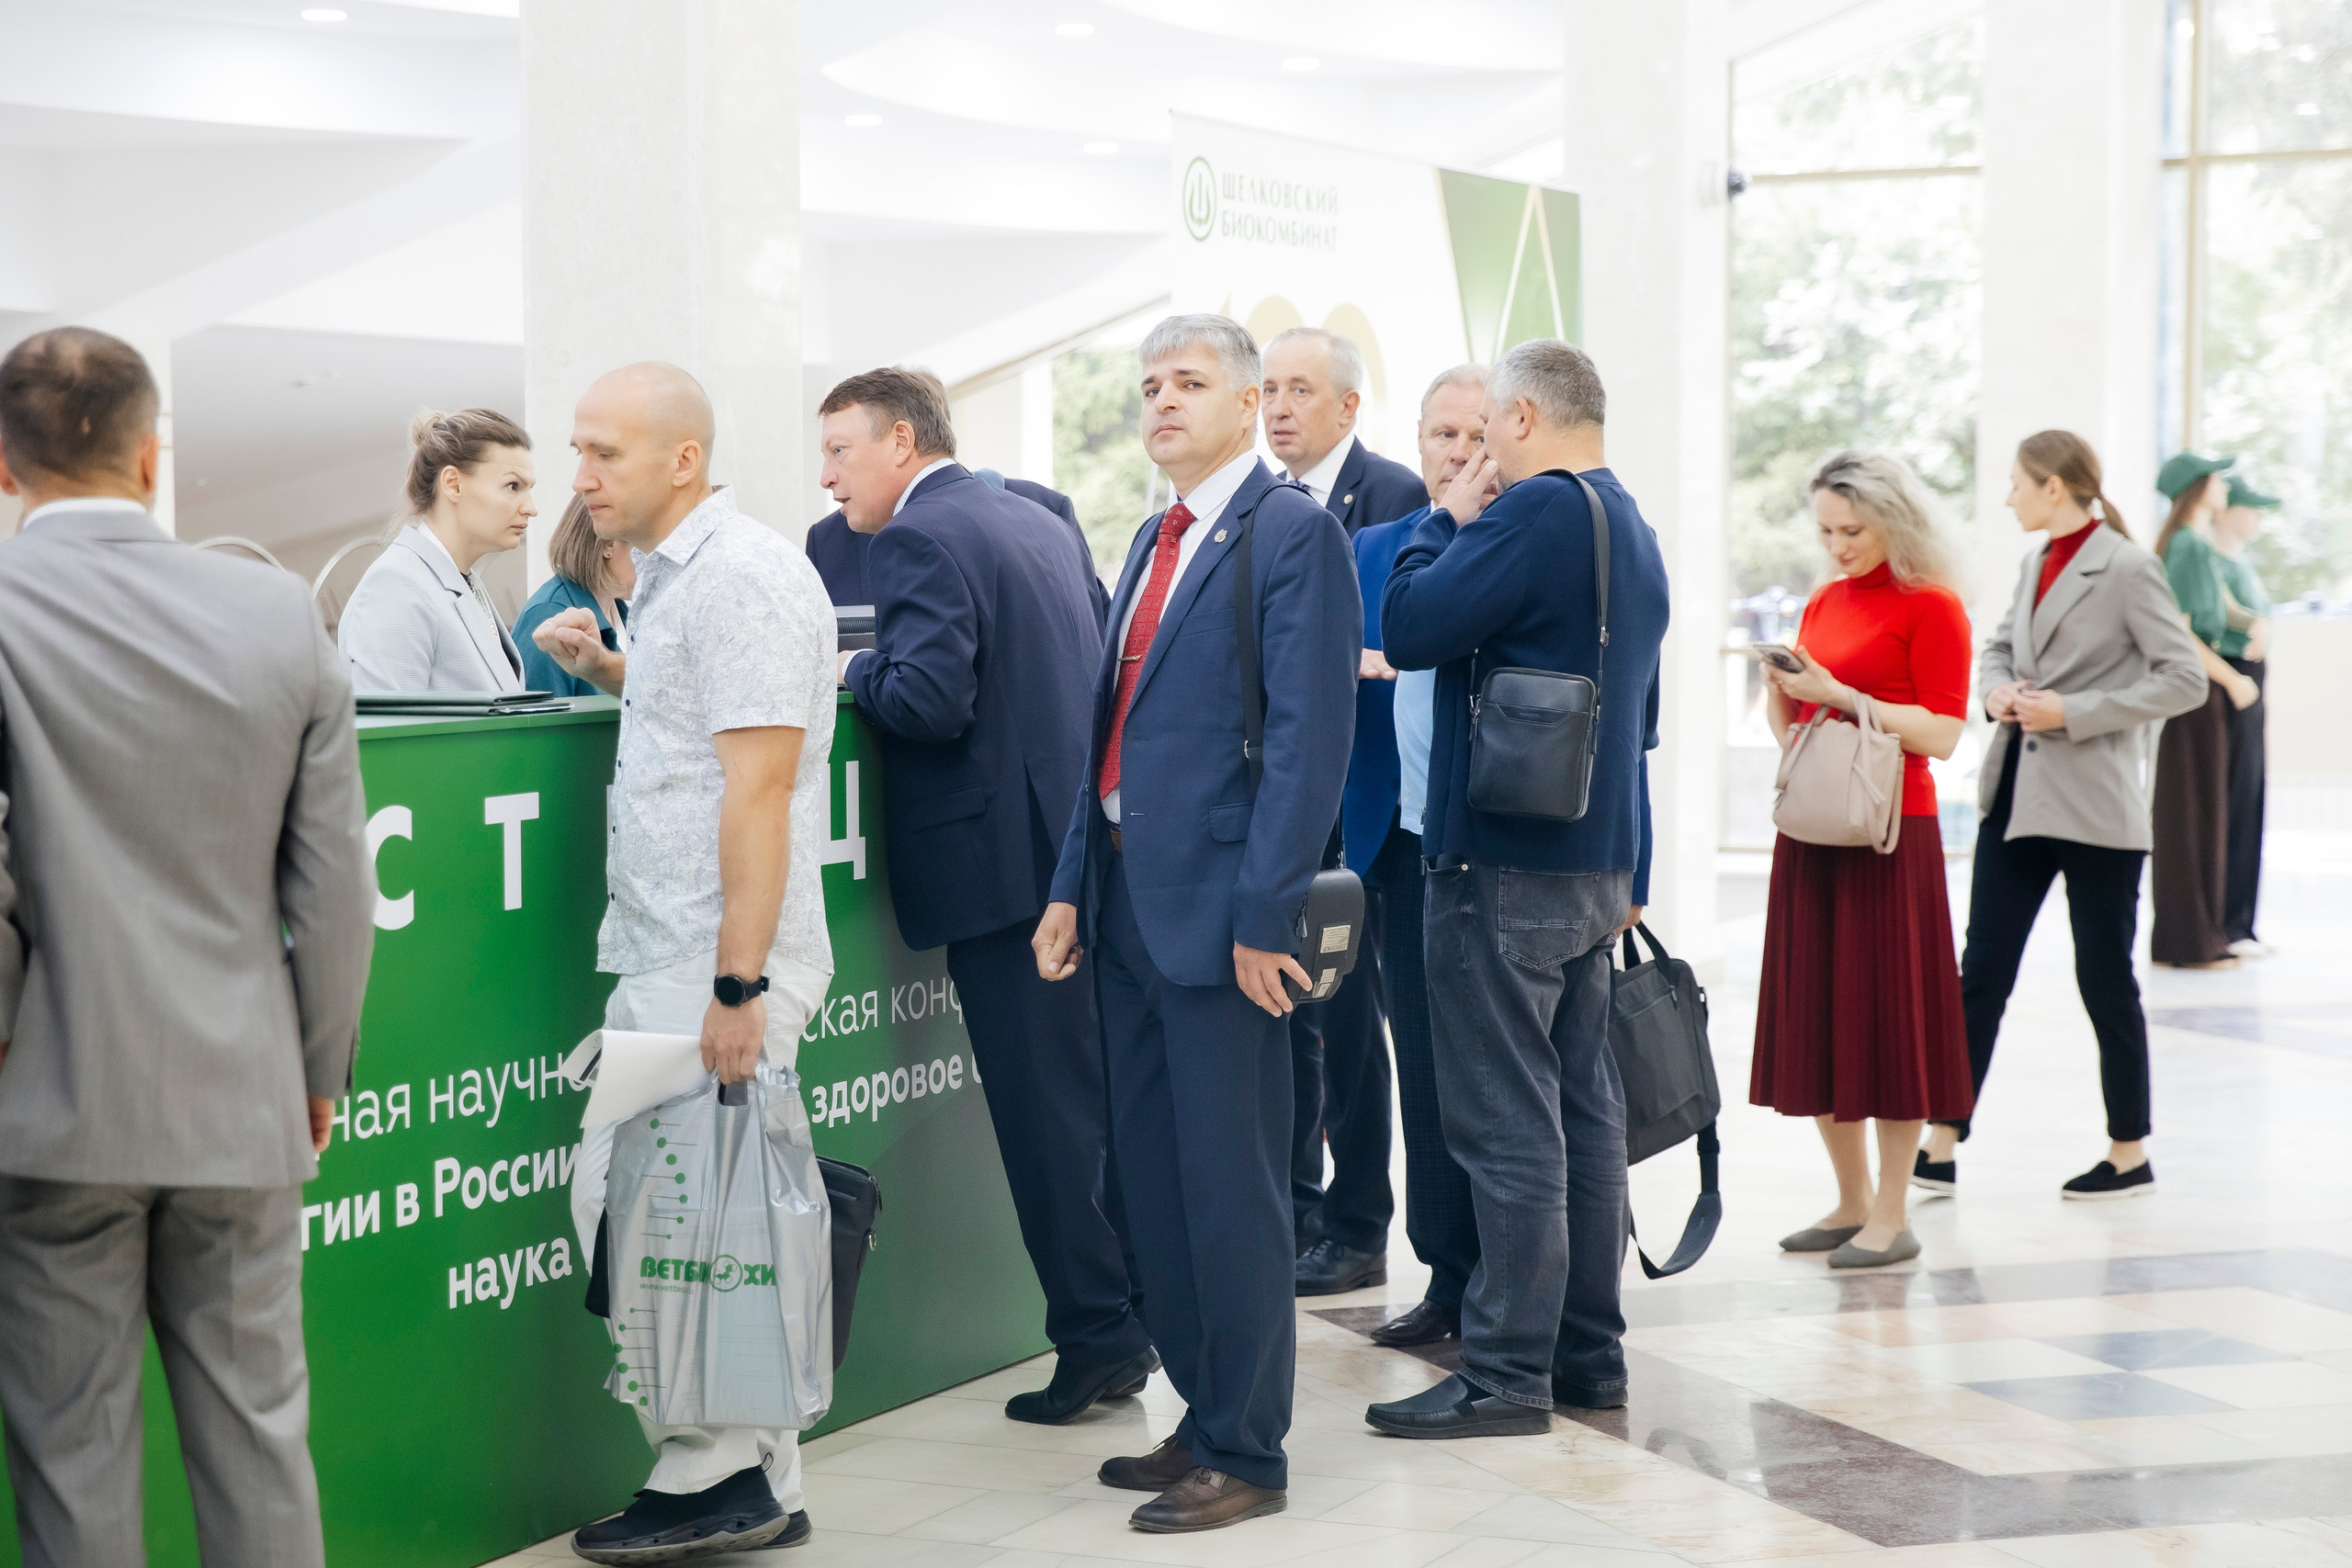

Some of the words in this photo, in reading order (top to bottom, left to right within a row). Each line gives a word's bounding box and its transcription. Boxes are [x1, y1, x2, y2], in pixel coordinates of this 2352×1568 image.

[1222, 210, 1338, 251] БИОКОМБИНАТ
[396, 1181, 420, 1228] в
[811, 1055, 963, 1128] здоровое
[448, 1237, 572, 1310] наука
